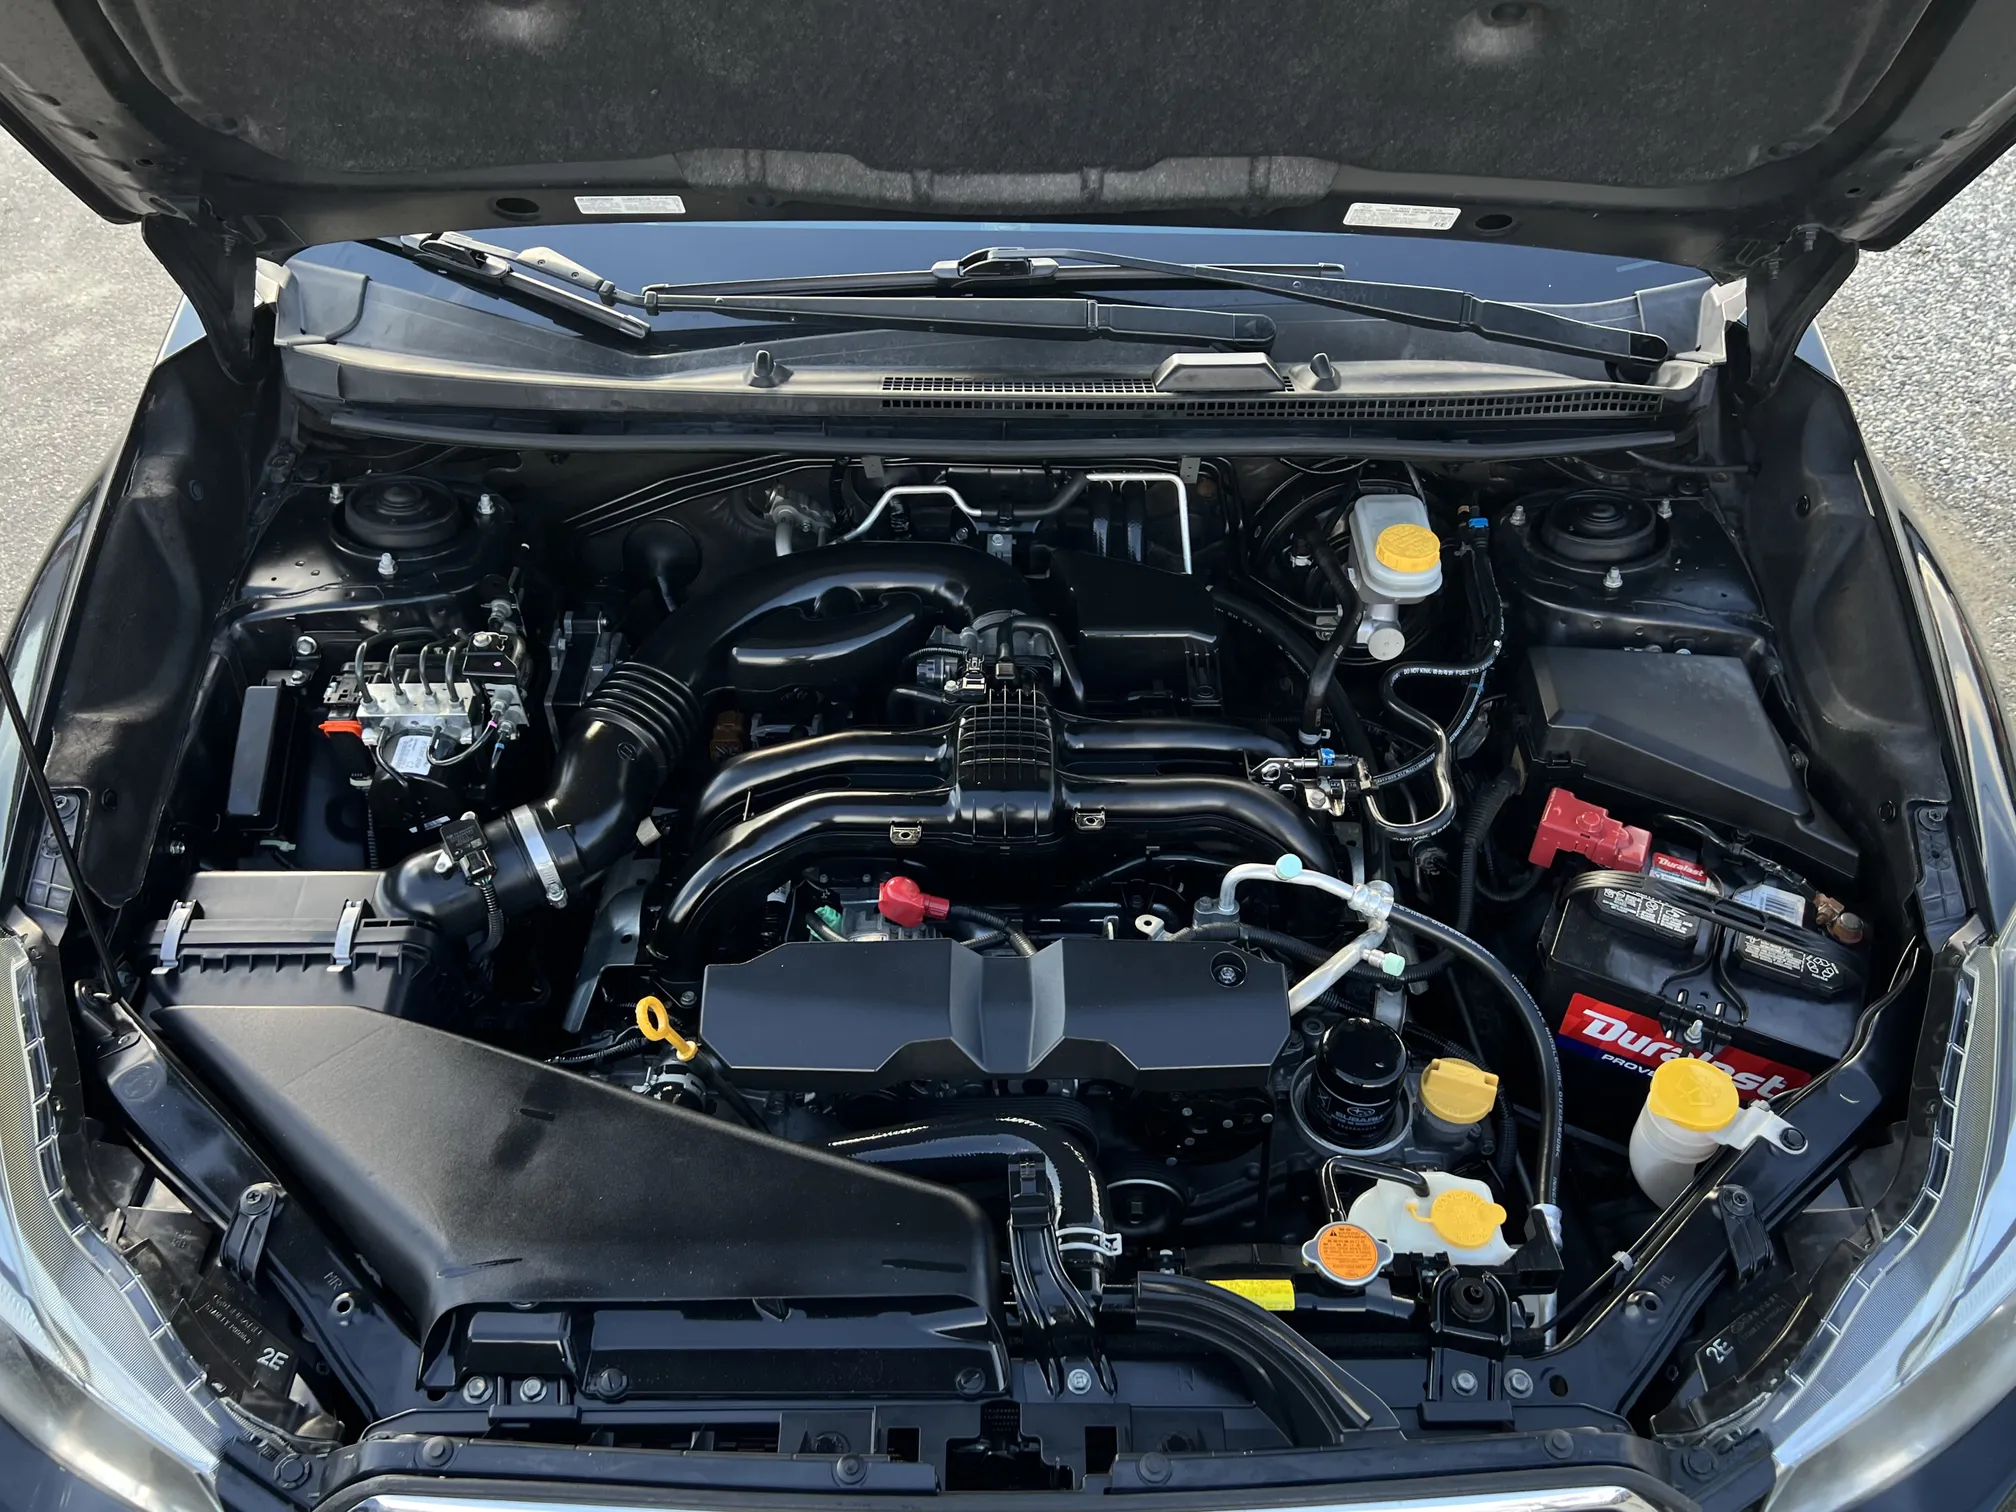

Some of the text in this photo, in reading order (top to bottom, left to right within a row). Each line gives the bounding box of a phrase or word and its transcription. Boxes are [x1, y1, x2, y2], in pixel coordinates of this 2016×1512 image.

[1656, 856, 1705, 877] Duralast
[1335, 1110, 1384, 1124] SUBARU
[323, 1271, 343, 1290] MR
[1656, 1274, 1676, 1289] ML
[256, 1347, 290, 1371] 2E
[1705, 1337, 1735, 1365] 2E
